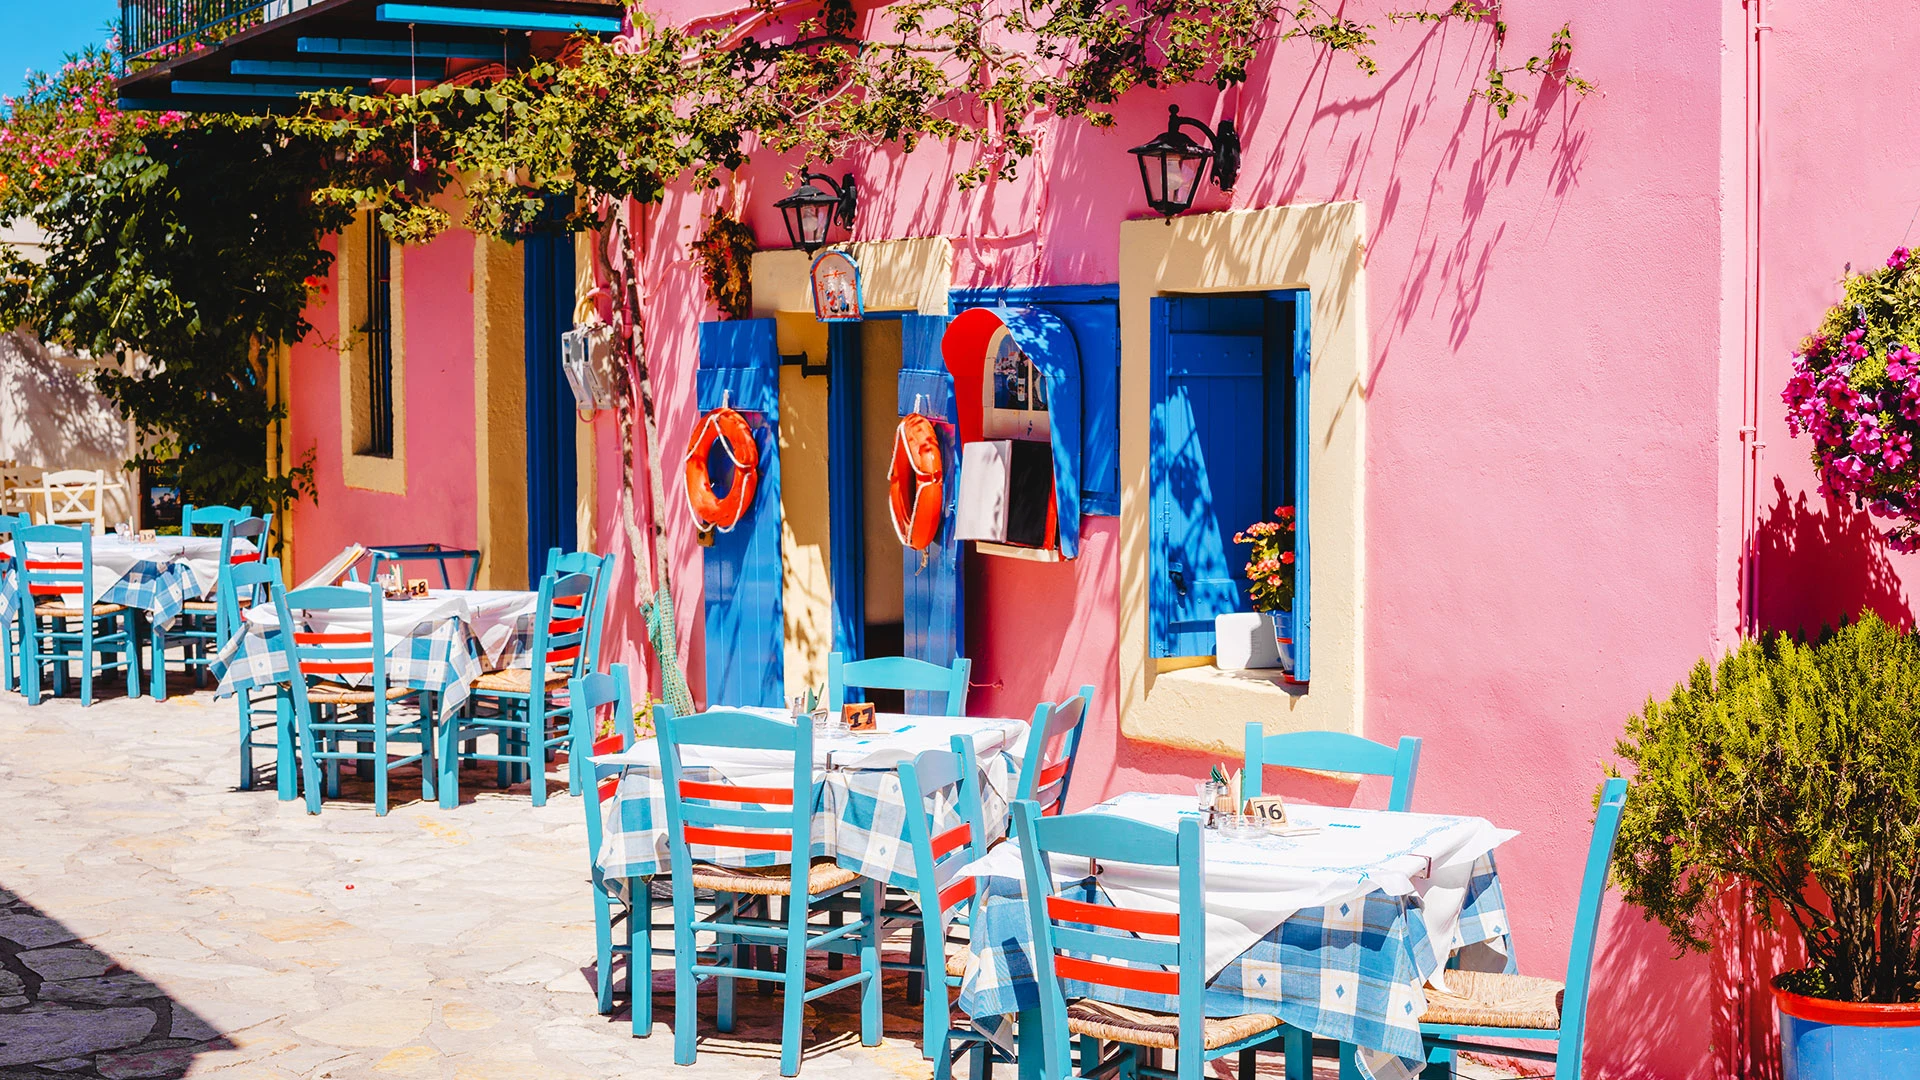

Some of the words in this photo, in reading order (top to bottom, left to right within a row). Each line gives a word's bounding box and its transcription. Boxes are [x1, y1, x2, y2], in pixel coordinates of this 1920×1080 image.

[411, 581, 426, 596] 18
[850, 707, 873, 728] 17
[1257, 803, 1282, 820] 16
